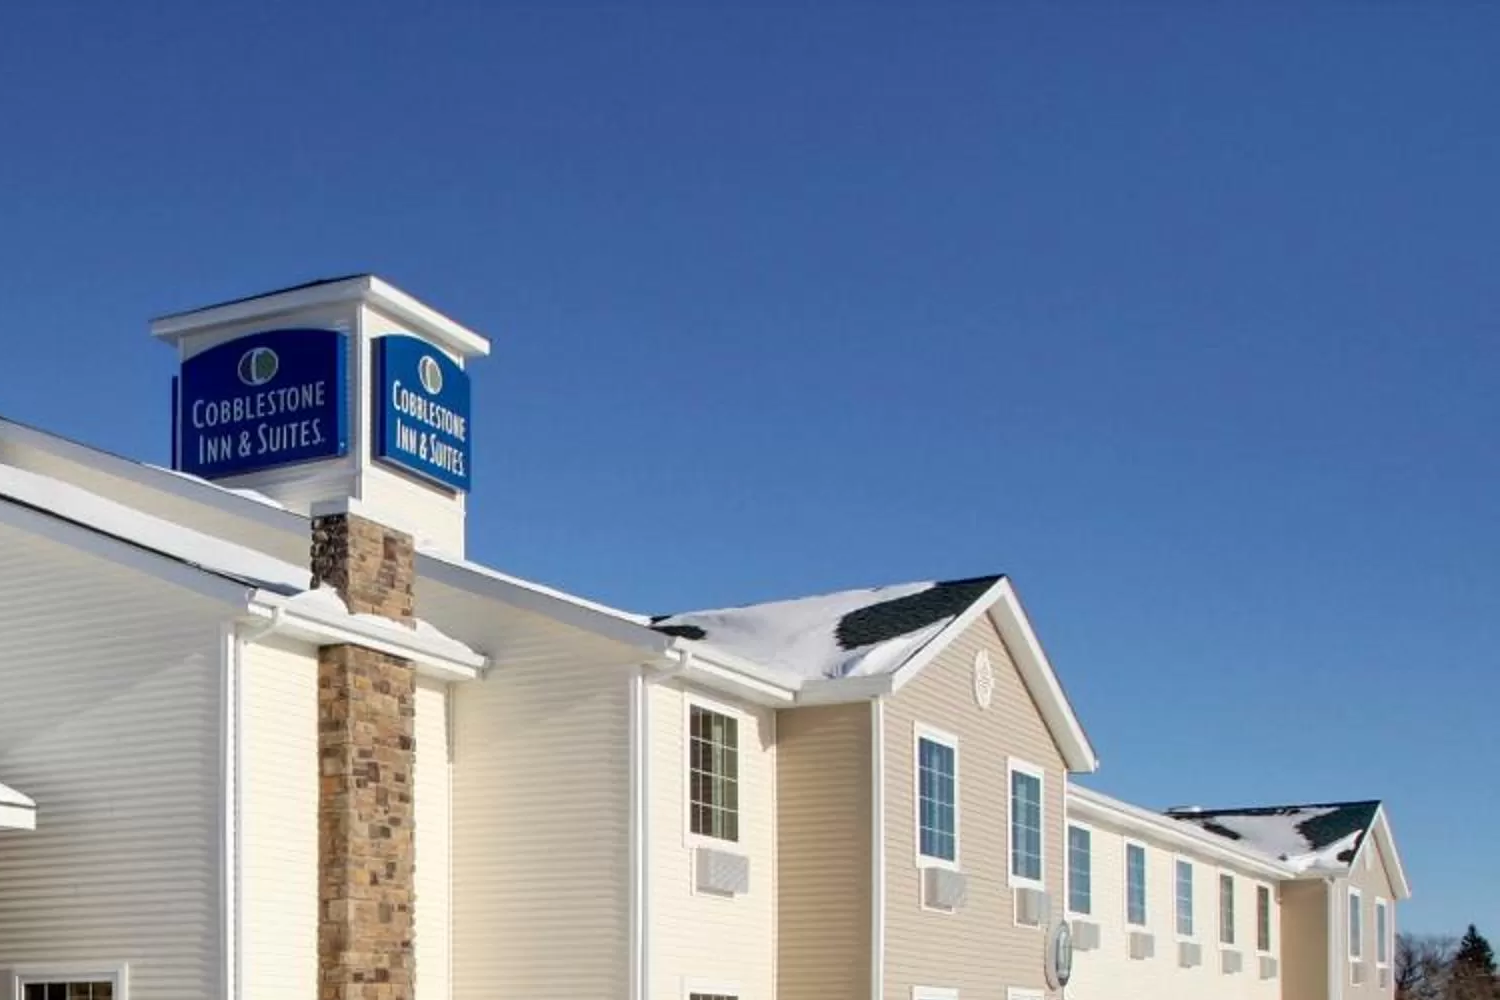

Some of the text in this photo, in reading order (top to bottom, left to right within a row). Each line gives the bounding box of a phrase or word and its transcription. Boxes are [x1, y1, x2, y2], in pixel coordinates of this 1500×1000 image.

[192, 381, 325, 429] COBBLESTONE
[393, 380, 466, 443] COBBLESTONE
[199, 434, 232, 465] INN
[238, 430, 252, 457] &
[396, 417, 417, 456] INN
[419, 431, 427, 460] &
